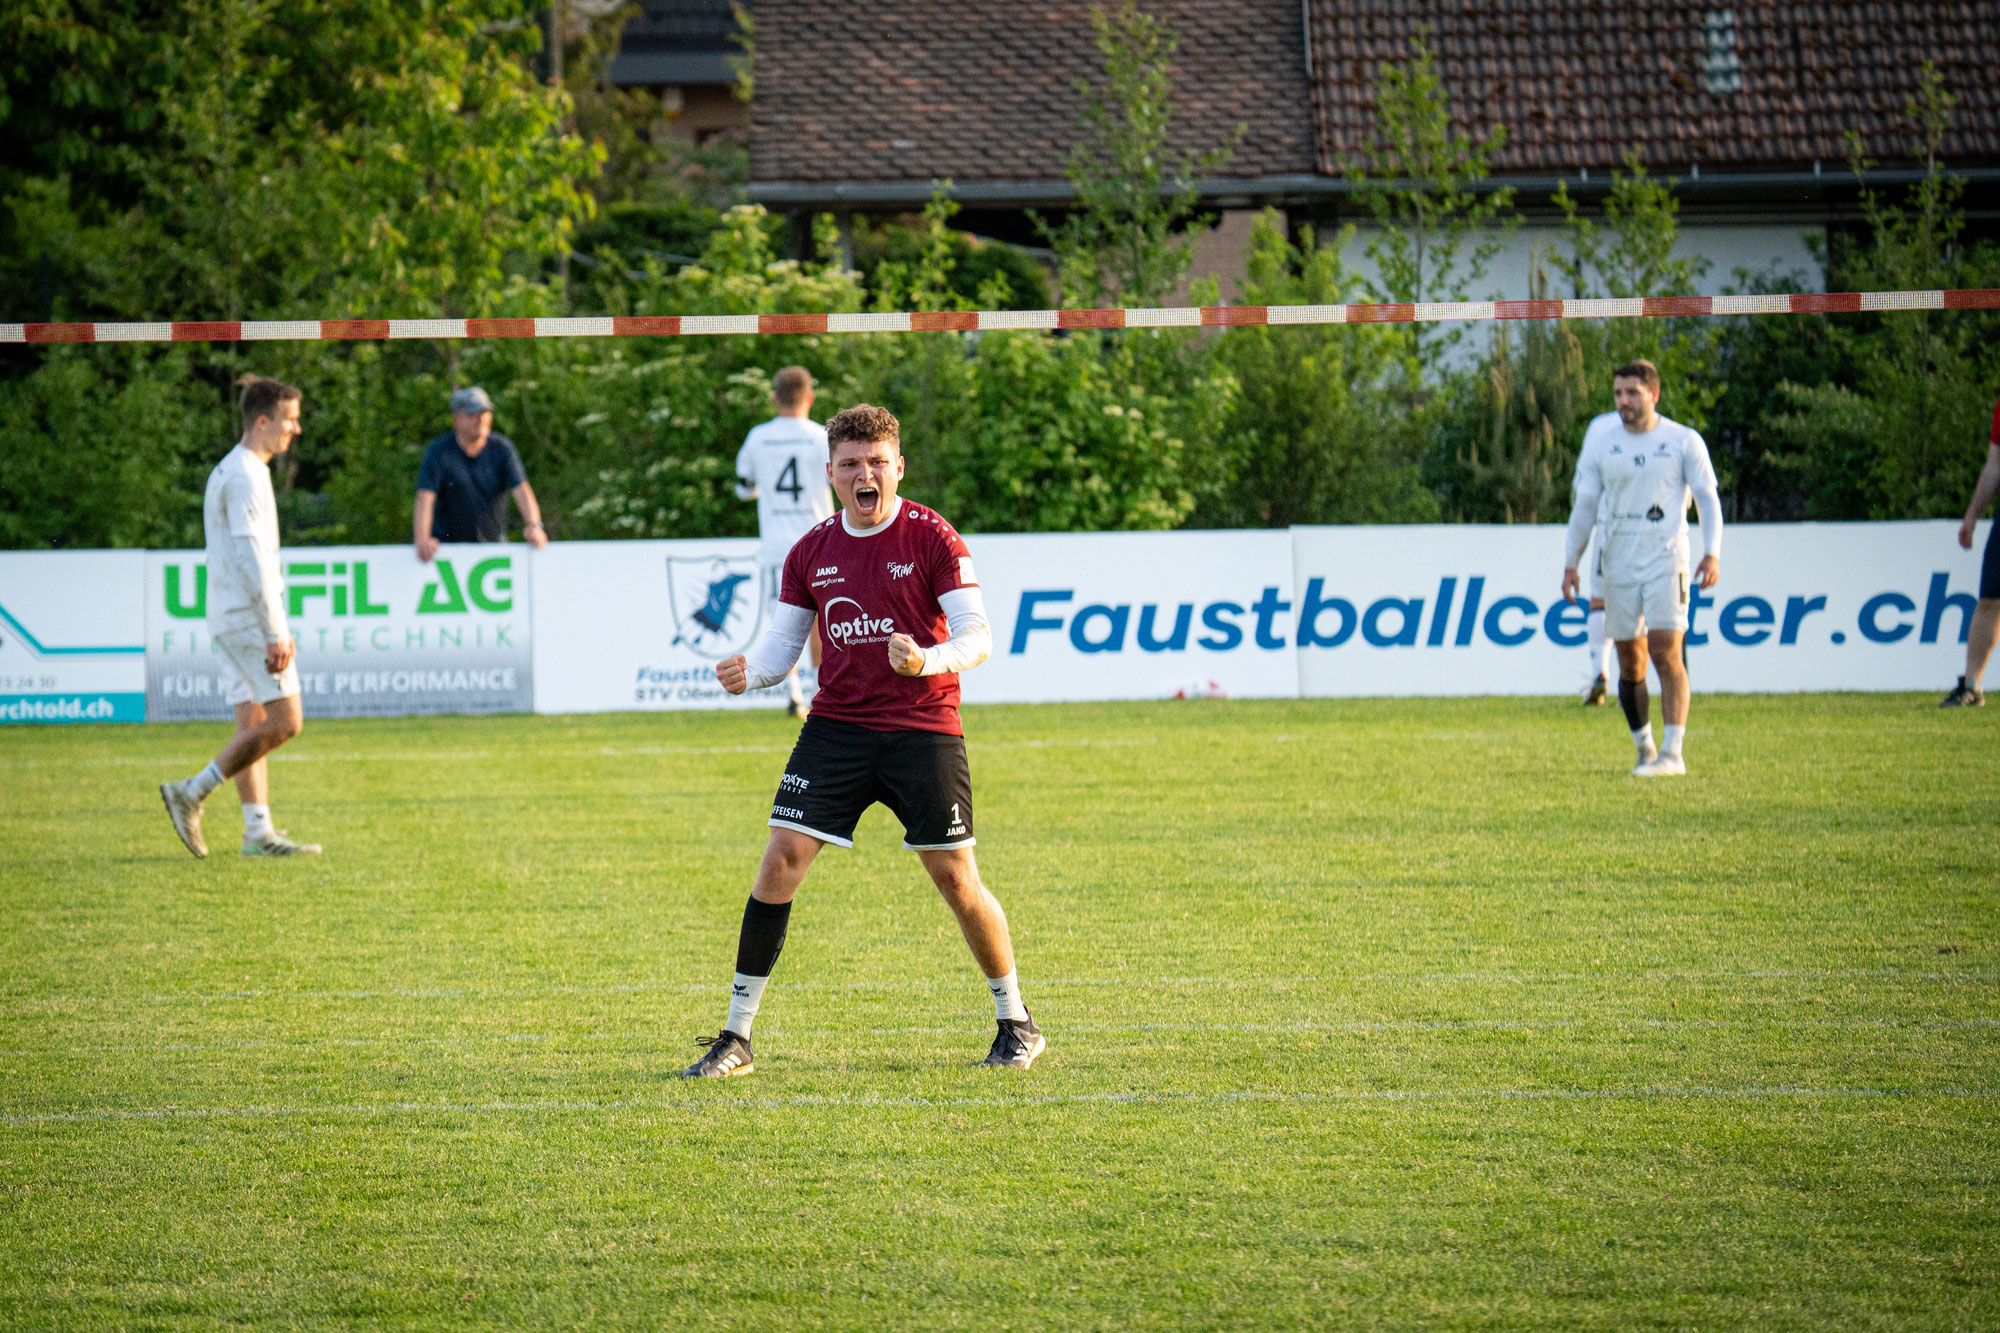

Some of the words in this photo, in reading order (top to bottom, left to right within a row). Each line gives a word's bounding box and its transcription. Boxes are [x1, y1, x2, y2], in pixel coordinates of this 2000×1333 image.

[775, 456, 804, 503] 4
[417, 557, 513, 613] AG
[816, 566, 838, 577] JAKO
[830, 613, 895, 644] optive
[1010, 572, 1977, 655] Faustballceter.ch
[163, 673, 211, 698] FÜR
[335, 667, 516, 694] PERFORMANCE
[951, 803, 963, 825] 1
[946, 825, 966, 837] JAKO
